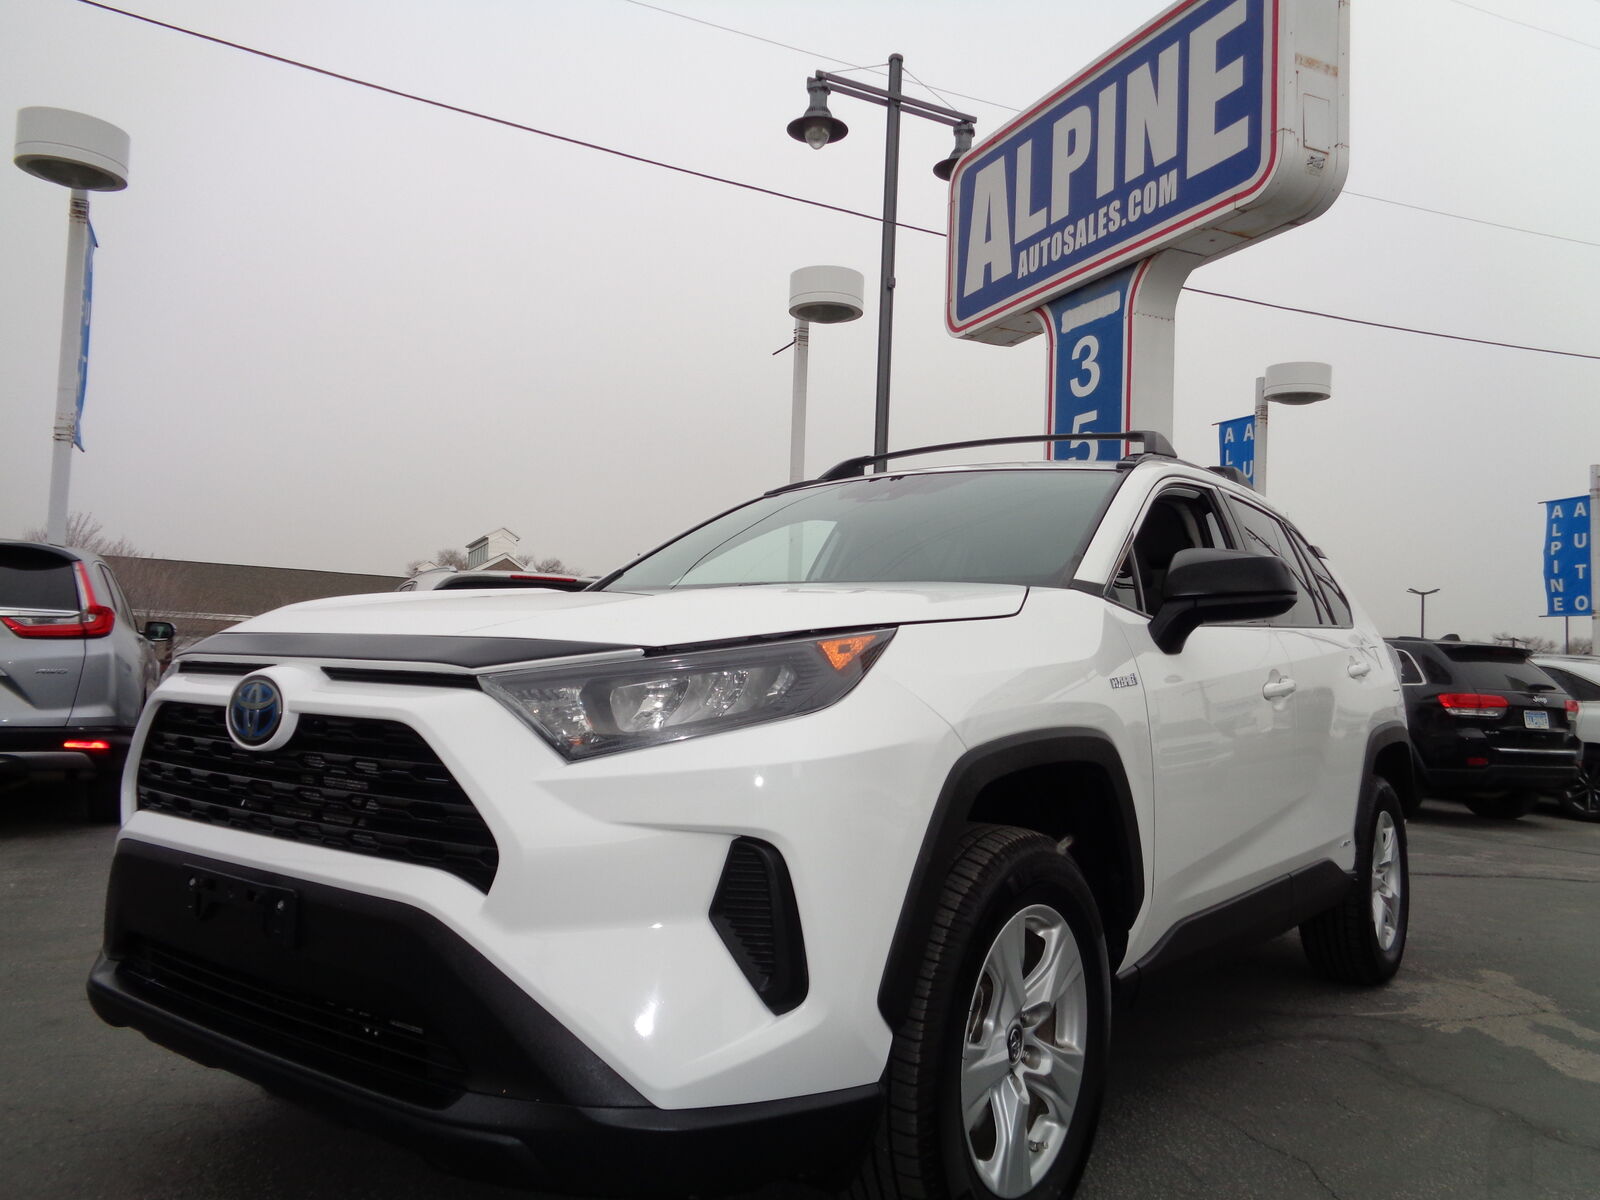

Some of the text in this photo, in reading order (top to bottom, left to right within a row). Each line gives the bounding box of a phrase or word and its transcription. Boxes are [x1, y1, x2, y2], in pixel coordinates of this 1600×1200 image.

[963, 0, 1249, 297] ALPINE
[1017, 168, 1178, 279] AUTOSALES.COM
[1550, 504, 1564, 612] ALPINE
[1573, 502, 1589, 612] AUTO
